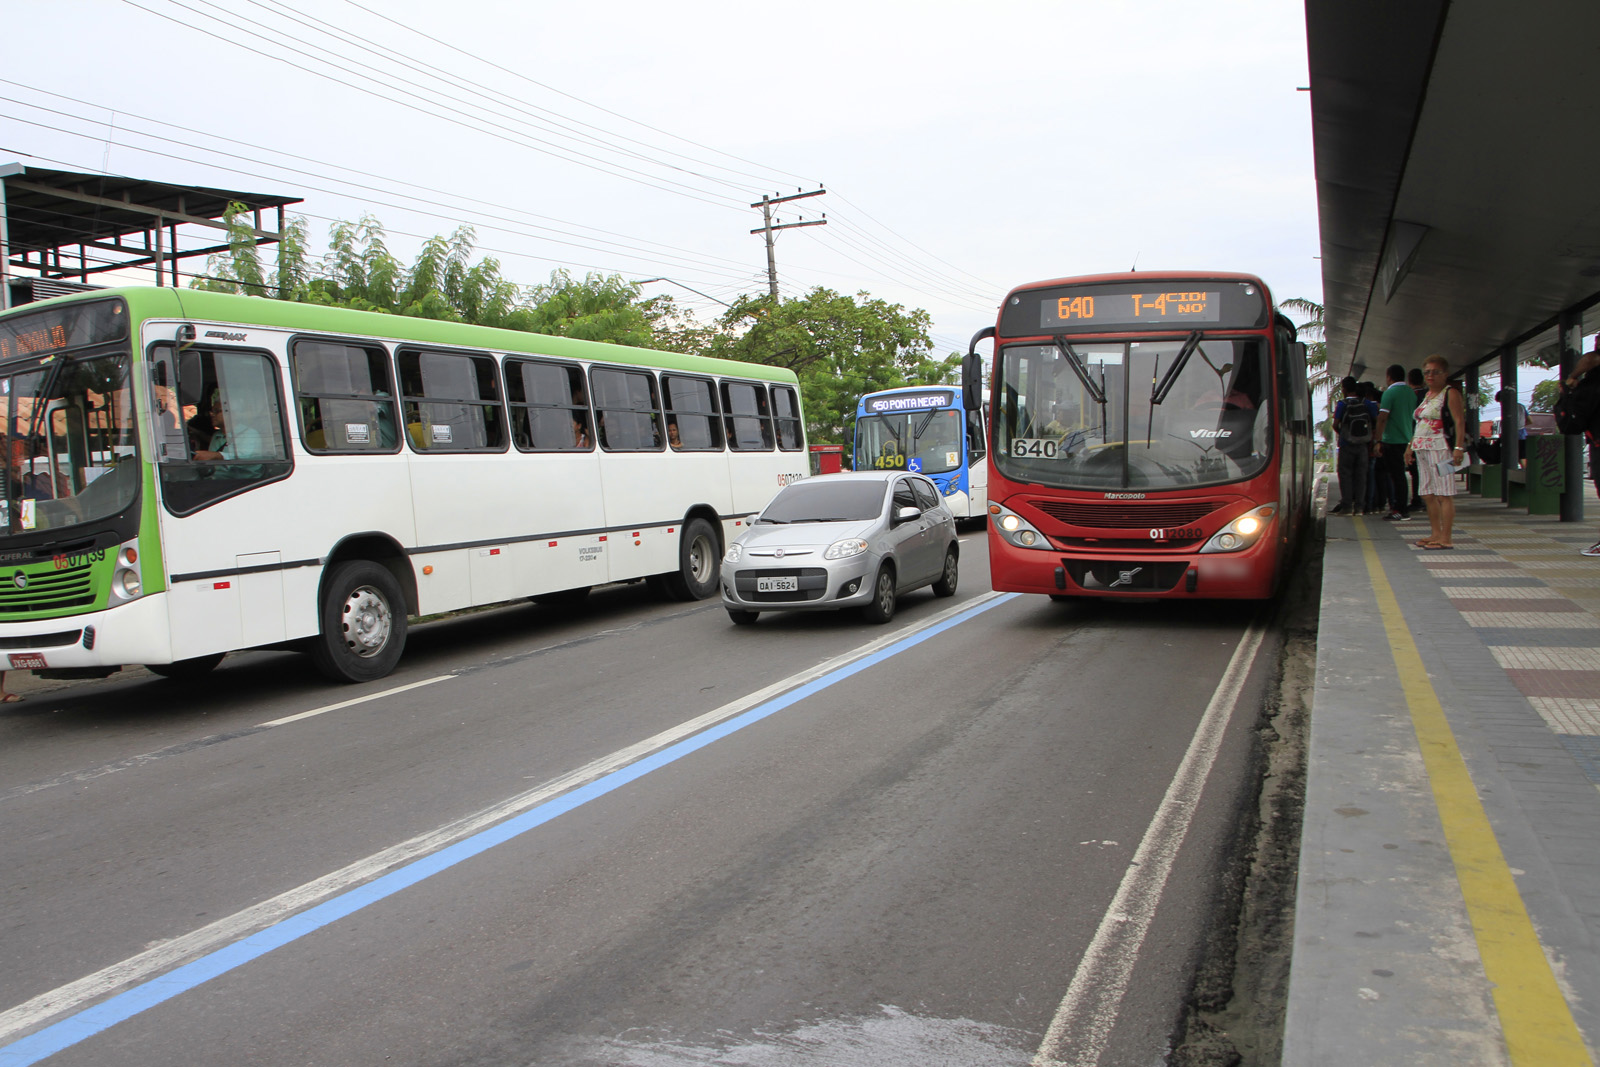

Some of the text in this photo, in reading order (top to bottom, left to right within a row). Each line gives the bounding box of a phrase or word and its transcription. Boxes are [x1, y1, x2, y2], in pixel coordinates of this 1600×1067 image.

[1058, 293, 1166, 319] 640 T-4
[872, 395, 945, 410] 450 PONTA NEGRA
[1190, 429, 1232, 438] Viale
[1014, 440, 1057, 458] 640
[875, 454, 904, 469] 450
[1149, 528, 1203, 539] 0112080
[0, 552, 33, 561] CIFERAL
[53, 547, 106, 570] 0507139
